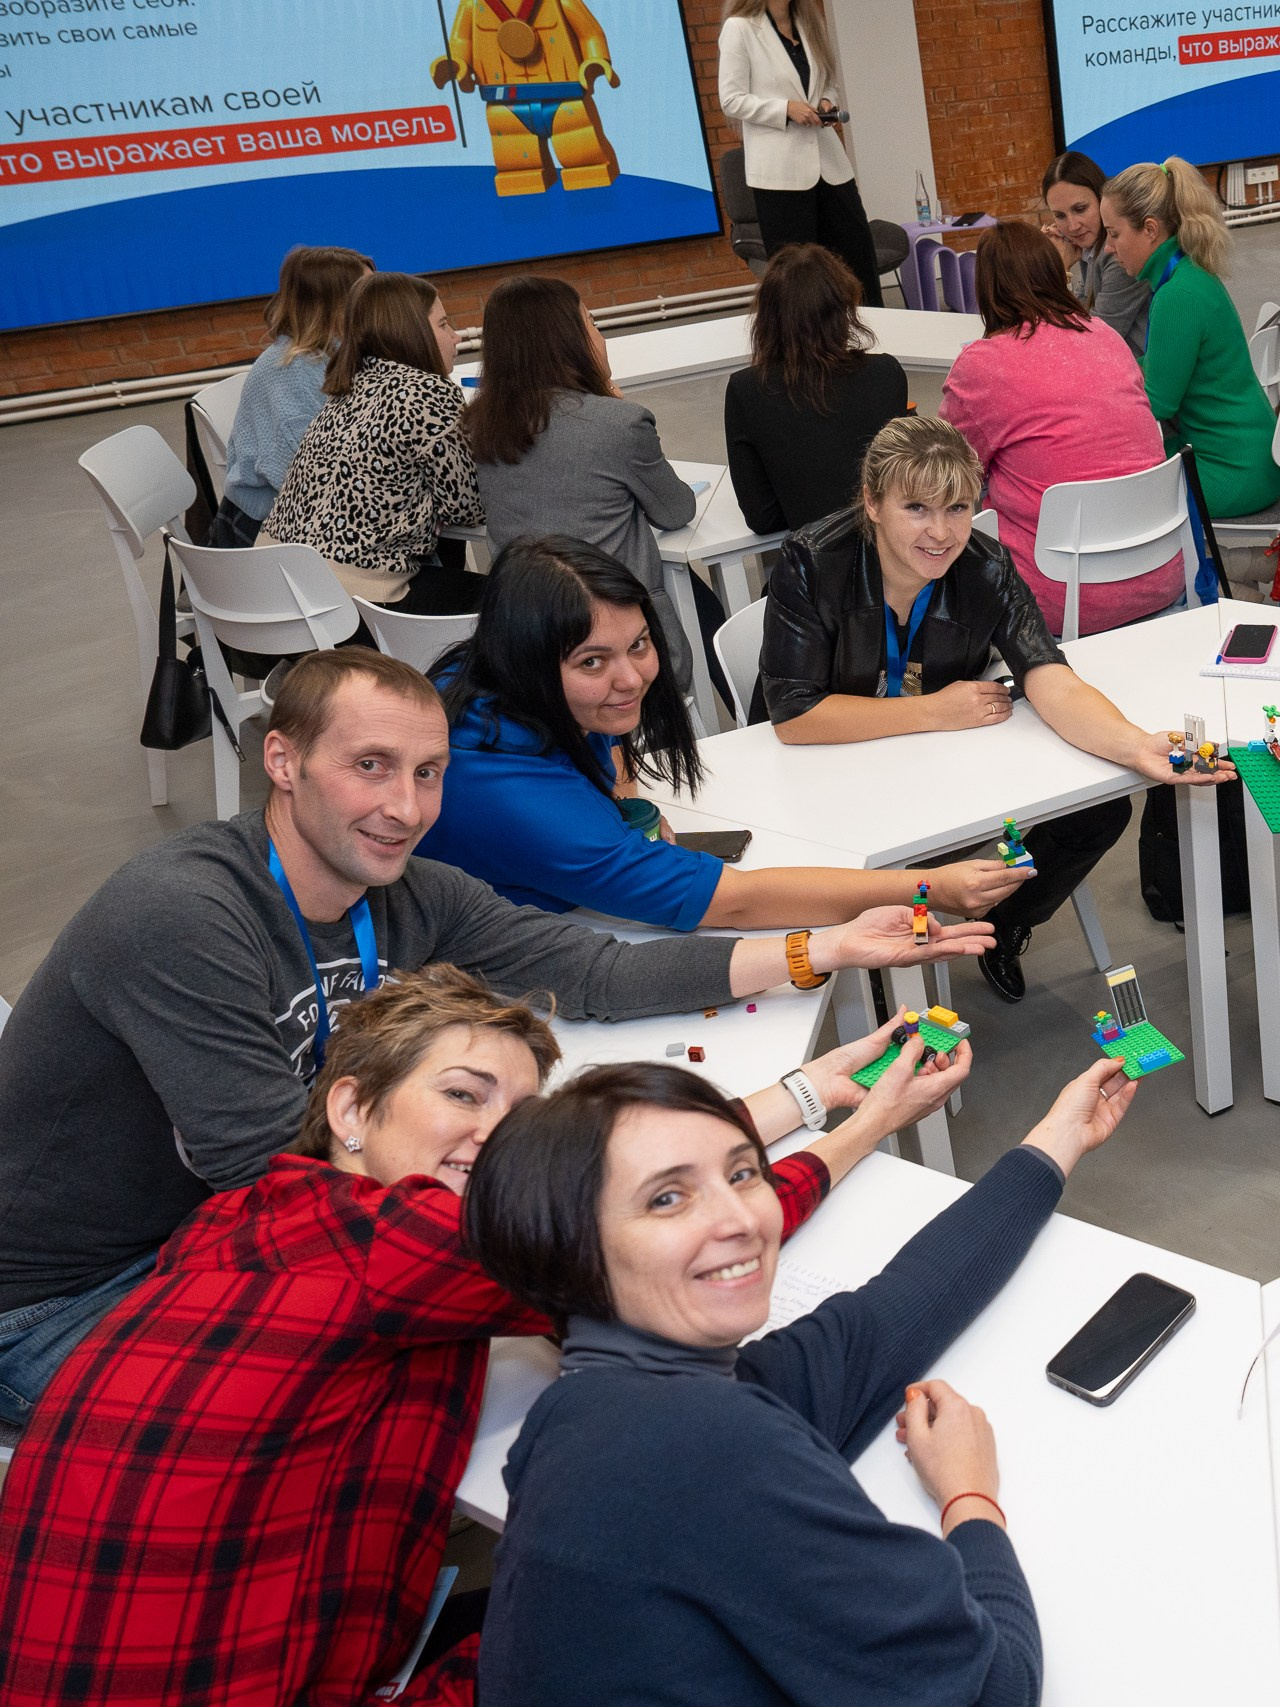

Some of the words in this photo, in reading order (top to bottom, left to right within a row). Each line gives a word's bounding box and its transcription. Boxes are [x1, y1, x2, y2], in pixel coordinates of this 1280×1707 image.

[57, 27, 117, 44] свои
[122, 21, 199, 40] самые
[1082, 10, 1197, 35] Расскажите
[1085, 45, 1178, 68] команды,
[1181, 39, 1213, 58] что
[5, 94, 214, 136] участникам
[223, 80, 322, 112] своей
[52, 136, 226, 172] выражает
[236, 126, 322, 154] ваша
[330, 115, 447, 144] модель
